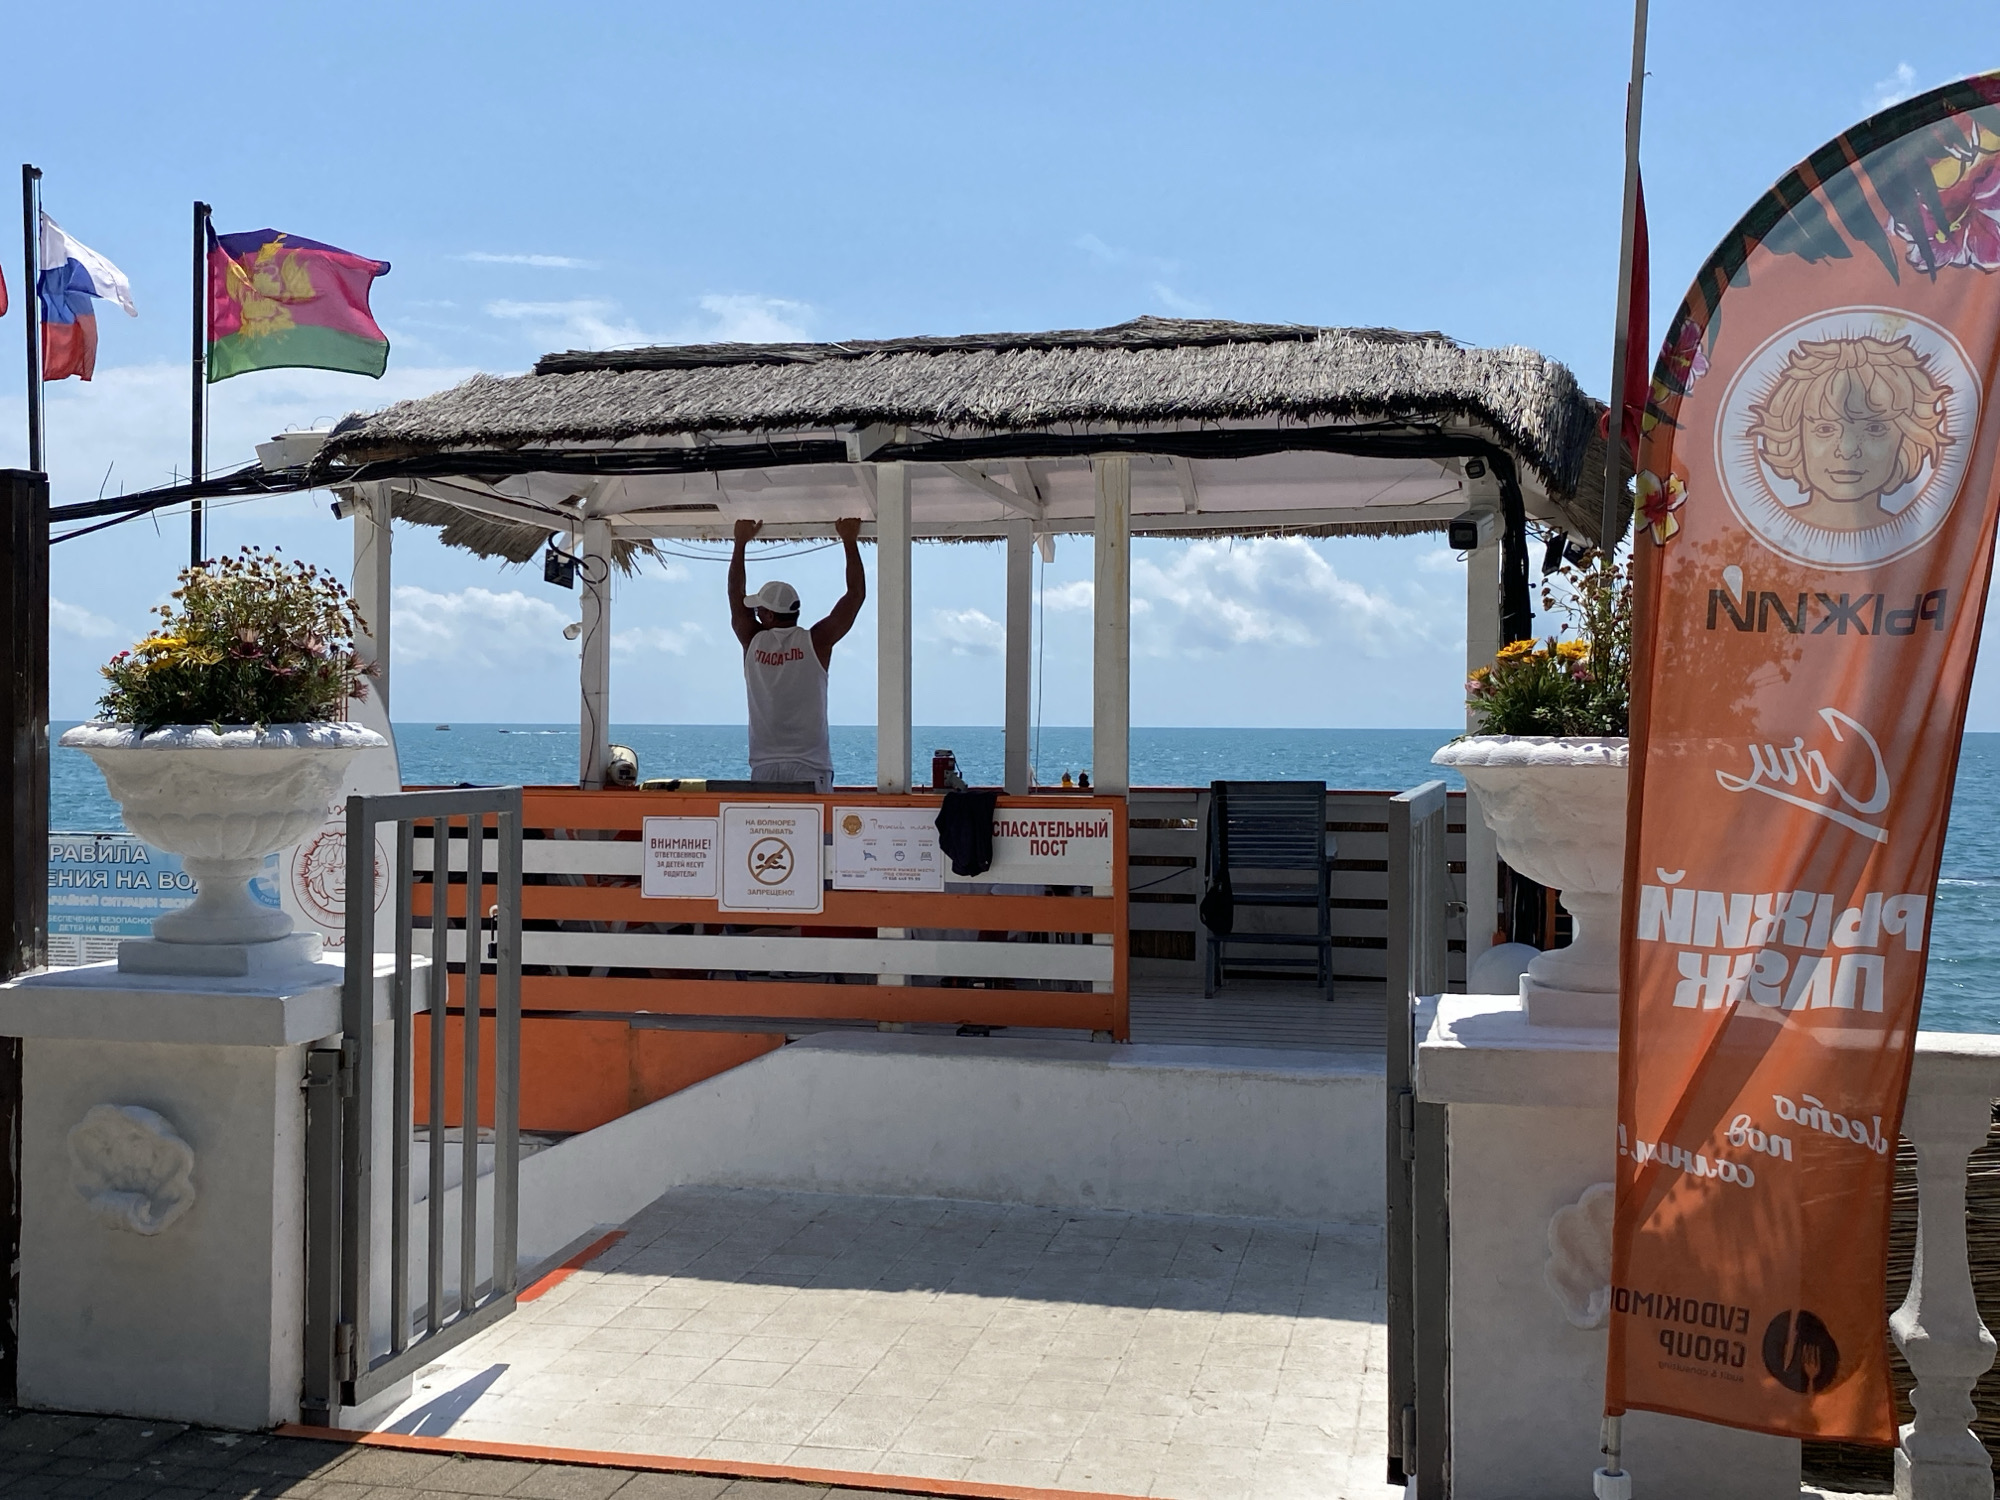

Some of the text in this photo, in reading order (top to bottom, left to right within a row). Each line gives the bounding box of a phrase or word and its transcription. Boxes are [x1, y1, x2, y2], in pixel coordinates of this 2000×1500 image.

[755, 648, 804, 666] СПАСАЕЛЬ
[992, 818, 1108, 838] СПАСАТЕЛЬНЫЙ
[651, 838, 711, 850] ВНИМАНИЕ!
[1030, 840, 1068, 857] ПОСТ
[49, 844, 150, 864] РАВИЛА
[665, 860, 685, 868] ДЕТЕЙ
[48, 869, 109, 888] ЕНИЯ
[116, 870, 152, 889] НА
[747, 889, 795, 897] ЗАПРЕЩЕНО!
[48, 915, 153, 925] БЕСПЕЧЕНИЯ БЕЗОПАСНОС
[58, 923, 120, 933] ДЕТЕЙ НА ВОДЕ
